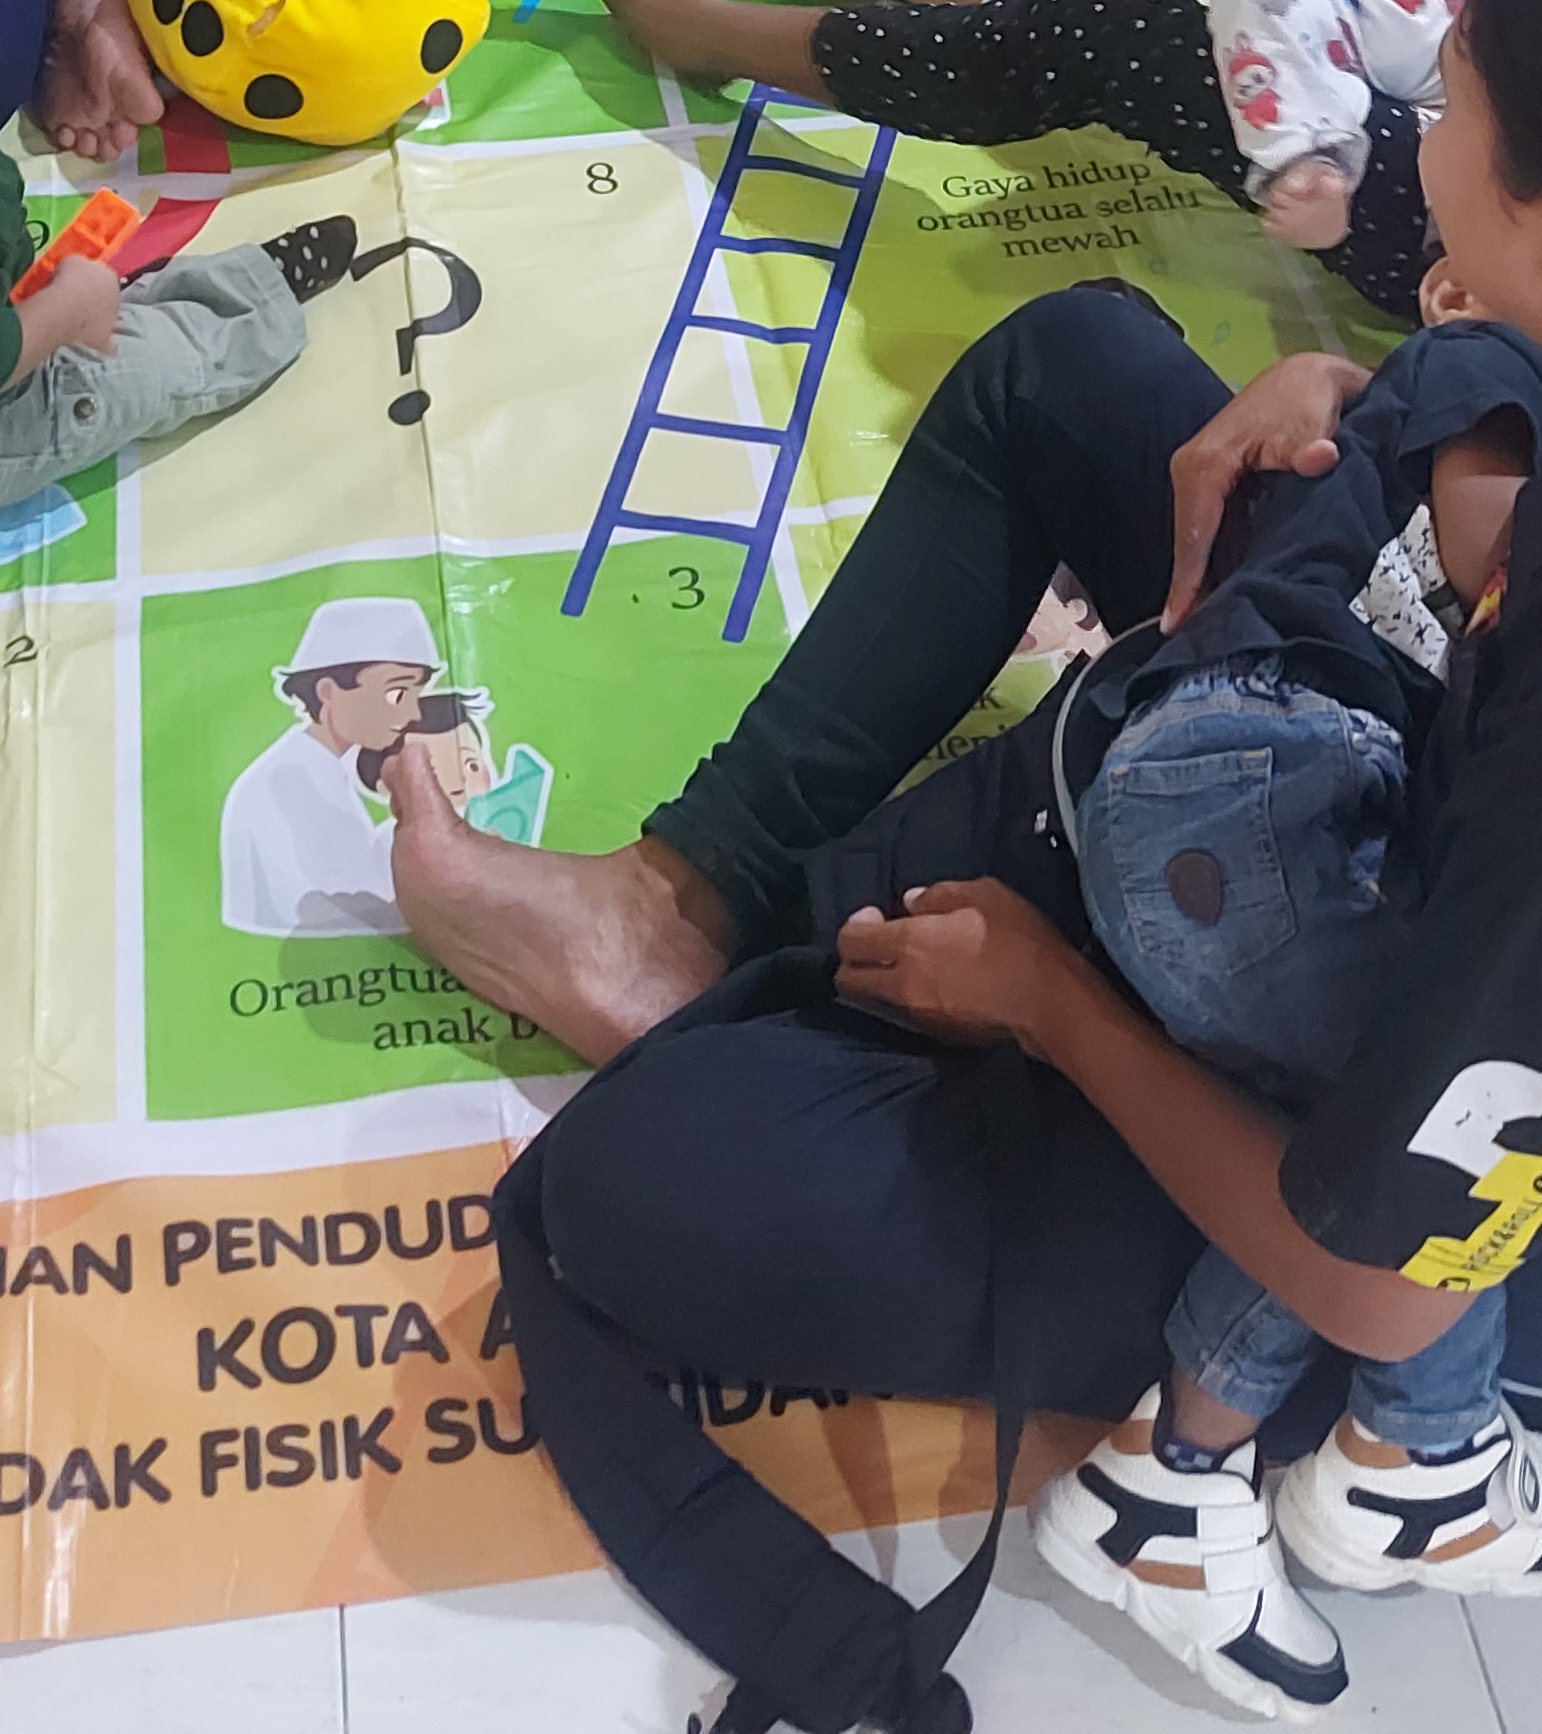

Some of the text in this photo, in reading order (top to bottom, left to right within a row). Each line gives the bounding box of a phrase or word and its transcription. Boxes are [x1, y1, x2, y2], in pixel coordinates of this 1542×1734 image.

[585, 162, 619, 195] 8
[941, 160, 1151, 200] Gaya hidup
[915, 186, 1204, 232] orangtua selalu
[1003, 225, 1143, 258] mewah
[667, 566, 706, 610] 3
[2, 635, 39, 669] 2
[229, 961, 468, 1017] Orangtua
[373, 1006, 495, 1050] anak
[162, 1193, 495, 1287] PENDUD
[196, 1300, 451, 1392] KOTA
[200, 1406, 403, 1498] FISIK
